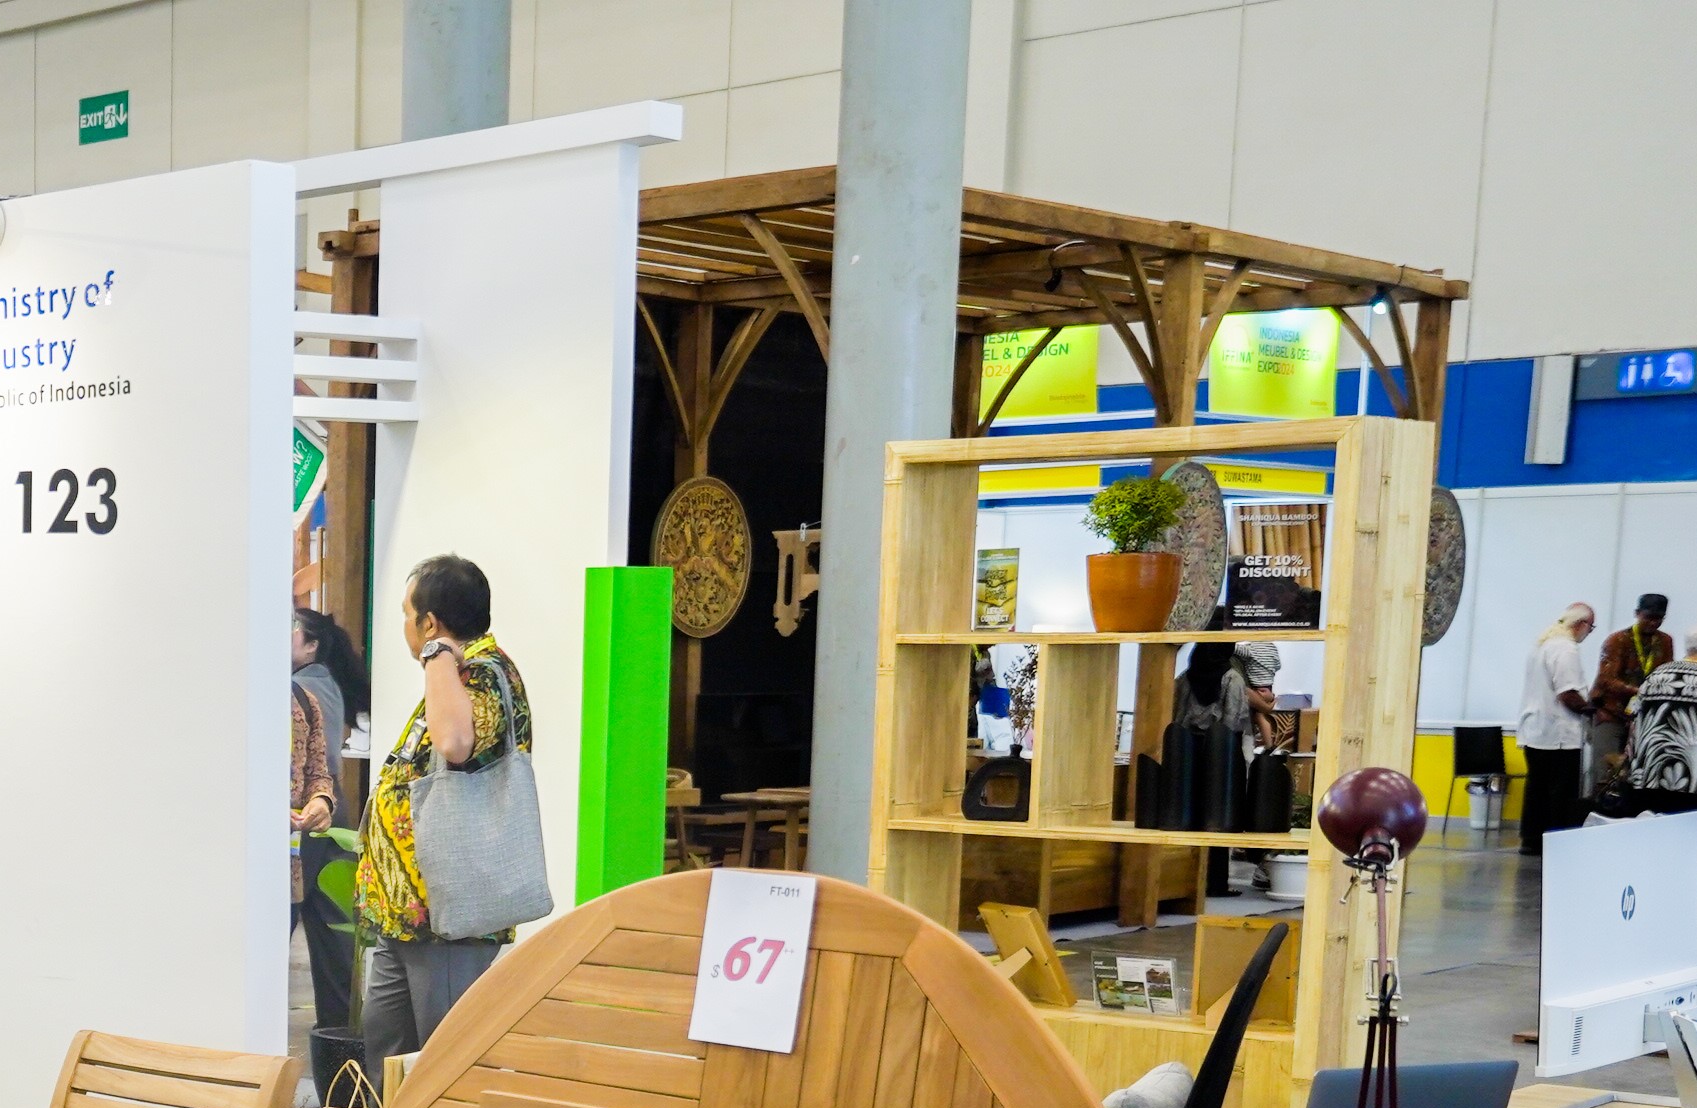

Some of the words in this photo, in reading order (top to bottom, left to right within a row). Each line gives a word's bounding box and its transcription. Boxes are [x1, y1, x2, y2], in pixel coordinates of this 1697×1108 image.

[80, 112, 104, 129] EXIT
[84, 269, 115, 307] of
[1017, 343, 1069, 358] DEIGN
[26, 384, 47, 406] of
[49, 376, 132, 402] Indonesia
[14, 467, 119, 535] 123
[1244, 555, 1273, 566] GET
[1274, 555, 1303, 566] 10%
[1238, 566, 1311, 578] DISCOUNT
[770, 886, 800, 898] FT-011
